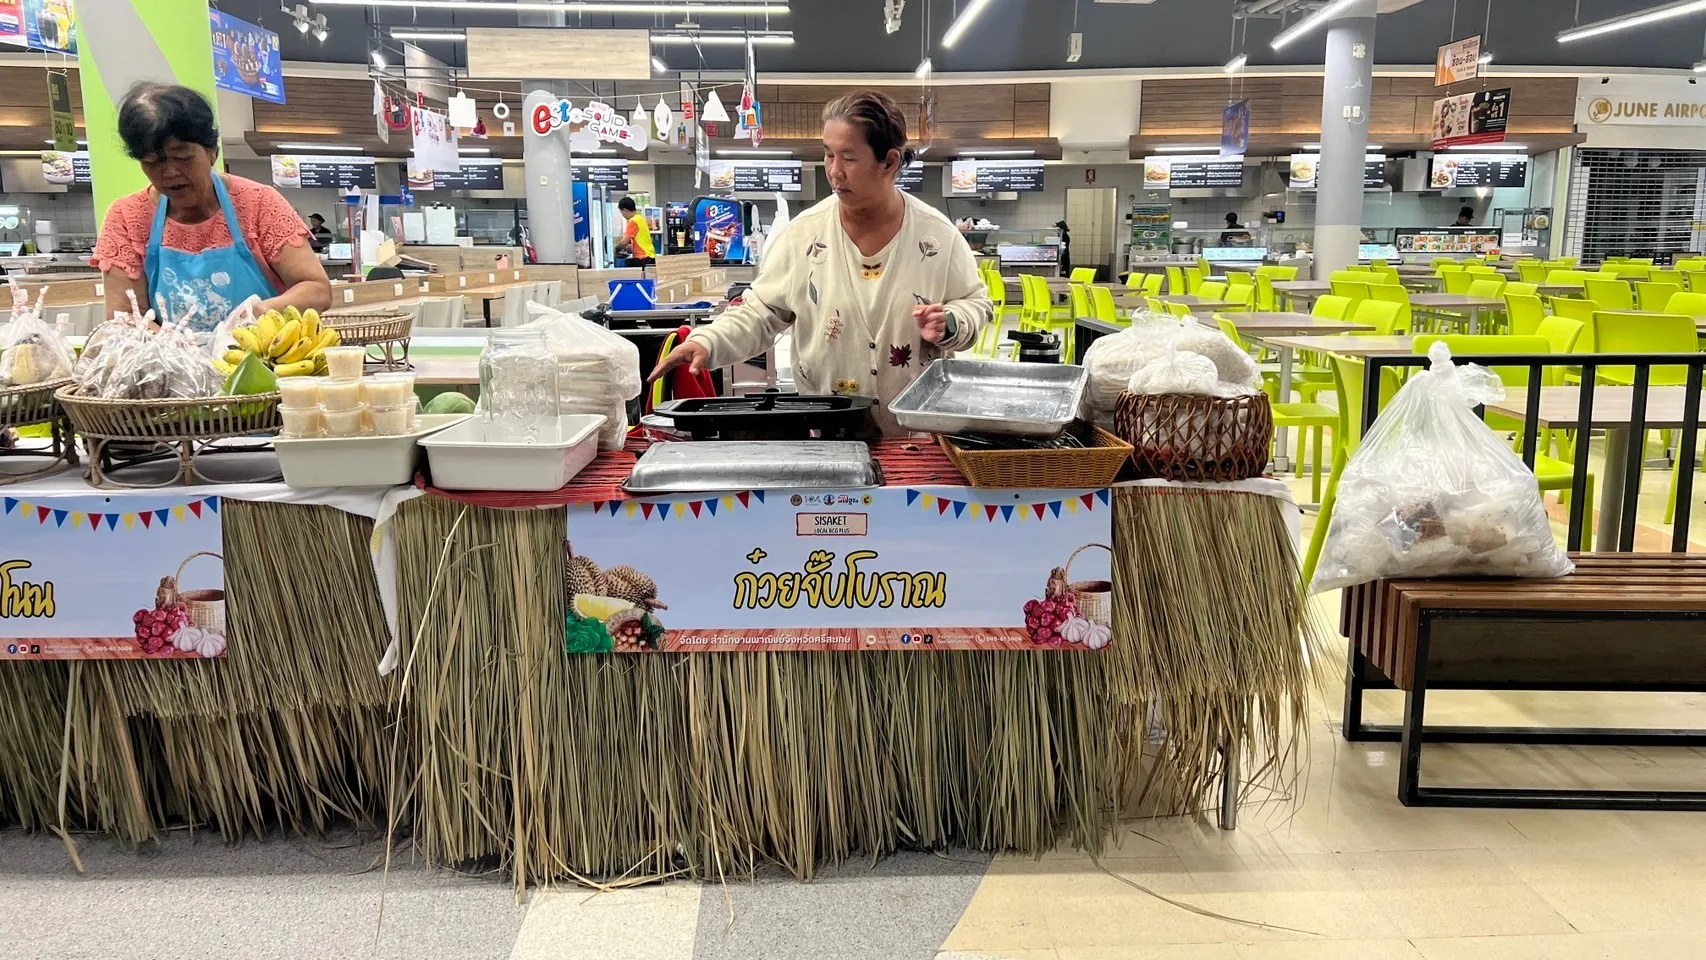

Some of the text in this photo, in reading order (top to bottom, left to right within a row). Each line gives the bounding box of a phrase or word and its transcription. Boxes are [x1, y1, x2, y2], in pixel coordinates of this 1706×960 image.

[533, 101, 570, 135] est
[584, 109, 625, 127] SQUID
[1613, 102, 1658, 118] JUNE
[814, 516, 847, 525] SISAKET
[679, 635, 708, 645] จัดโดย
